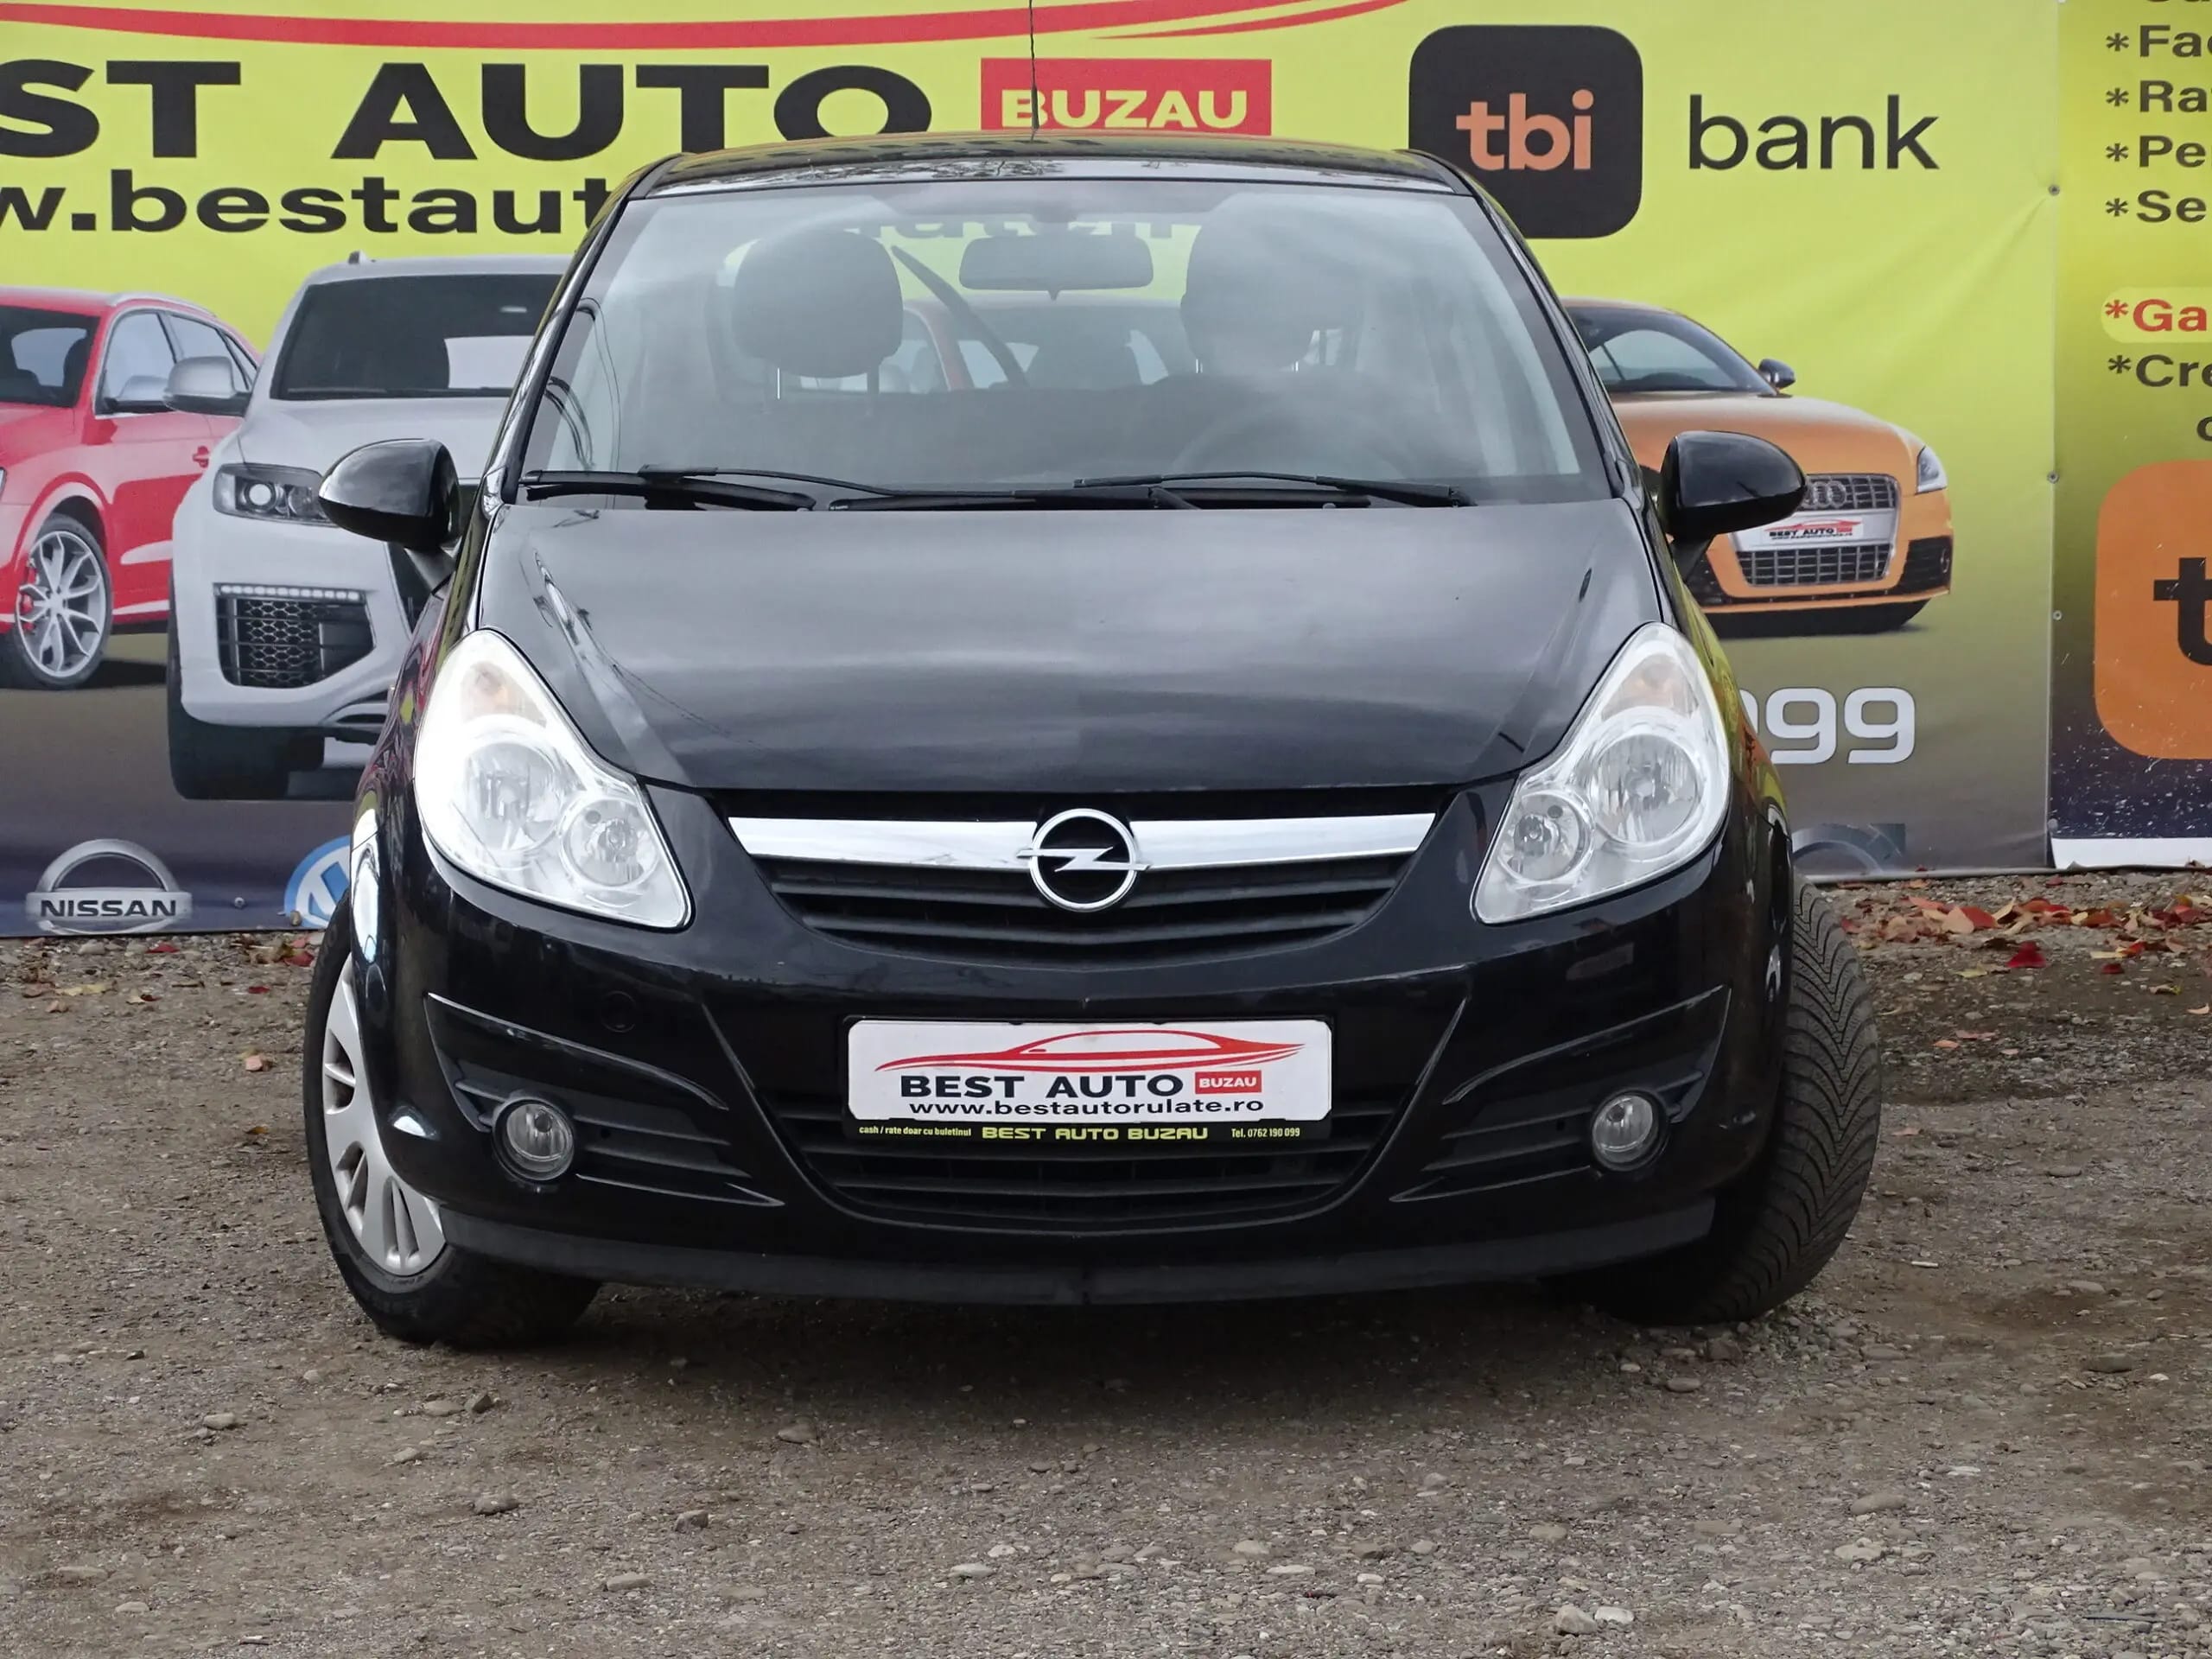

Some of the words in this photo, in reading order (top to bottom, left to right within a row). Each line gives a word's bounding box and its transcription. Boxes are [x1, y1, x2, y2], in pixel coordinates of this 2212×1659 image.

[2106, 24, 2212, 57] Fa
[331, 62, 932, 161] AUTO
[1001, 89, 1247, 129] BUZAU
[2106, 79, 2212, 112] Ra
[1456, 89, 1594, 171] tbi
[1688, 94, 1940, 170] bank
[2106, 135, 2212, 168] Pe
[40, 899, 176, 918] NISSAN
[900, 1075, 1025, 1098] BEST
[1046, 1074, 1184, 1098] AUTO
[1198, 1077, 1258, 1089] BUZAU
[910, 1098, 1263, 1115] www.bestautorulate.ro
[859, 1125, 879, 1135] cash
[903, 1126, 921, 1135] doar
[934, 1127, 971, 1136] buletinul
[982, 1127, 1046, 1140] BEST
[1055, 1128, 1119, 1140] AUTO
[1128, 1128, 1208, 1140] BUZAU
[1231, 1128, 1246, 1138] Tel.
[1248, 1128, 1268, 1137] 0762
[1269, 1128, 1283, 1137] 190
[1284, 1128, 1300, 1137] 099
